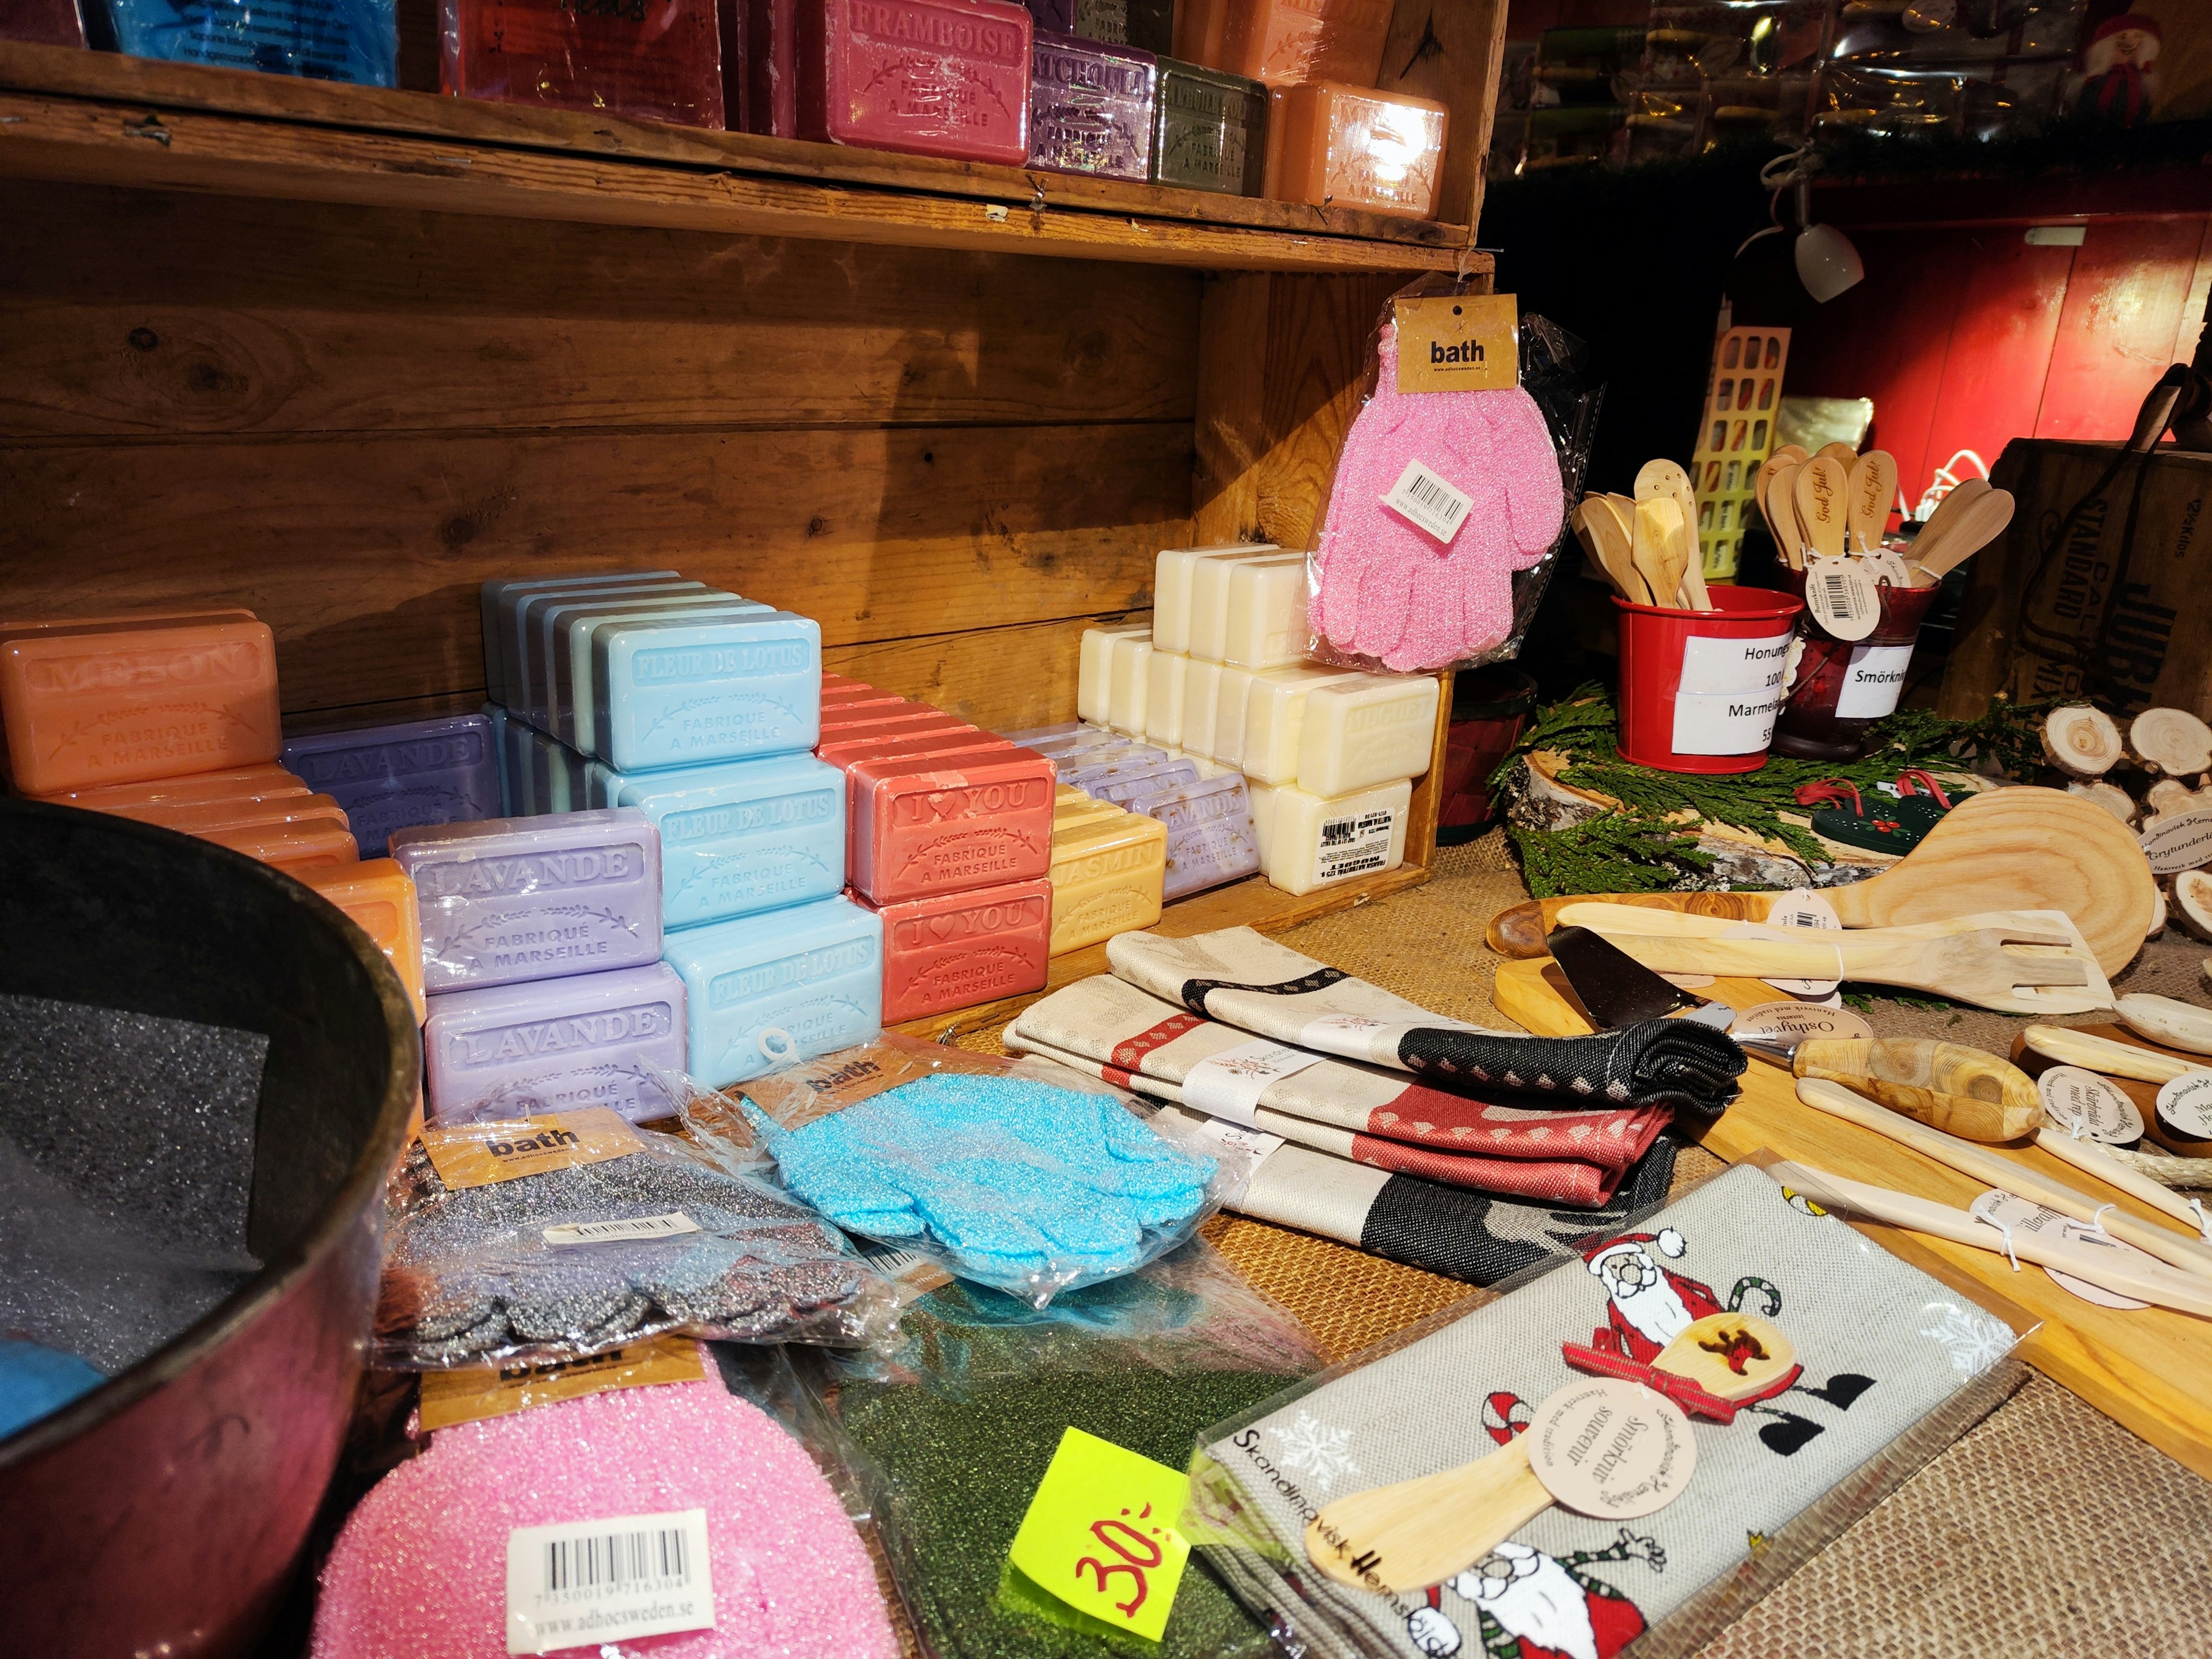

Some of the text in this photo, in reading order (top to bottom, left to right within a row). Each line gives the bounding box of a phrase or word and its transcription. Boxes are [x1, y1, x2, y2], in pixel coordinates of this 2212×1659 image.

[855, 3, 1017, 56] FRAMBOISE
[889, 100, 898, 113] A
[1183, 157, 1190, 169] A
[1431, 340, 1484, 364] bath
[1812, 467, 1834, 524] God Jul!
[1861, 461, 1883, 518] God Jul!
[1396, 498, 1447, 536] www.adhocsweden.se
[2054, 497, 2108, 620] STANDARD
[1809, 584, 1821, 613] Butterknife
[637, 643, 803, 680] FLEUR DE LOTUS
[671, 726, 781, 749] A MARSEILLE
[1762, 727, 1771, 742] 55
[88, 737, 227, 768] A MARSEILLE
[310, 737, 471, 783] LAVANDE
[912, 781, 1029, 820] I YOU
[666, 794, 830, 842] FLEUR DE LOTUS
[433, 846, 629, 897] LAVANDE
[922, 857, 1017, 884] A MARSEILLE
[1053, 841, 1156, 888] JASMIN
[1183, 846, 1237, 872] A MARSEILLE
[1330, 855, 1380, 870] MUGUET
[2188, 857, 2203, 866] med
[699, 877, 806, 908] A MARSEILLE
[485, 922, 590, 950] FABRIQUÉ
[912, 900, 1025, 945] I YOU
[1069, 910, 1139, 940] A MARSEILLE
[469, 941, 608, 970] A MARSEILLE
[712, 942, 869, 1004] FLEUR DE LOTUS
[922, 974, 1016, 1004] A MARSEILLE
[1746, 1008, 1773, 1022] tradition
[1759, 1019, 1835, 1035] Osthyvel
[1777, 1014, 1805, 1022] intarsia
[1794, 1006, 1836, 1017] Hantverk
[464, 1006, 658, 1065] LAVANDE
[744, 1054, 755, 1066] A
[806, 1061, 882, 1094] bath
[2067, 1085, 2086, 1118] med rep
[2166, 1082, 2203, 1115] Skandinavisk
[485, 1130, 581, 1157] bath
[1542, 1388, 1608, 1467] Hantverk med tradition
[1567, 1406, 1613, 1466] souvenir
[1592, 1415, 1649, 1484] Smörkniv
[1233, 1429, 1352, 1559] Skandinavisk
[1075, 1501, 1162, 1618] 30:-
[535, 1600, 695, 1637] www.adhocsweden.se
